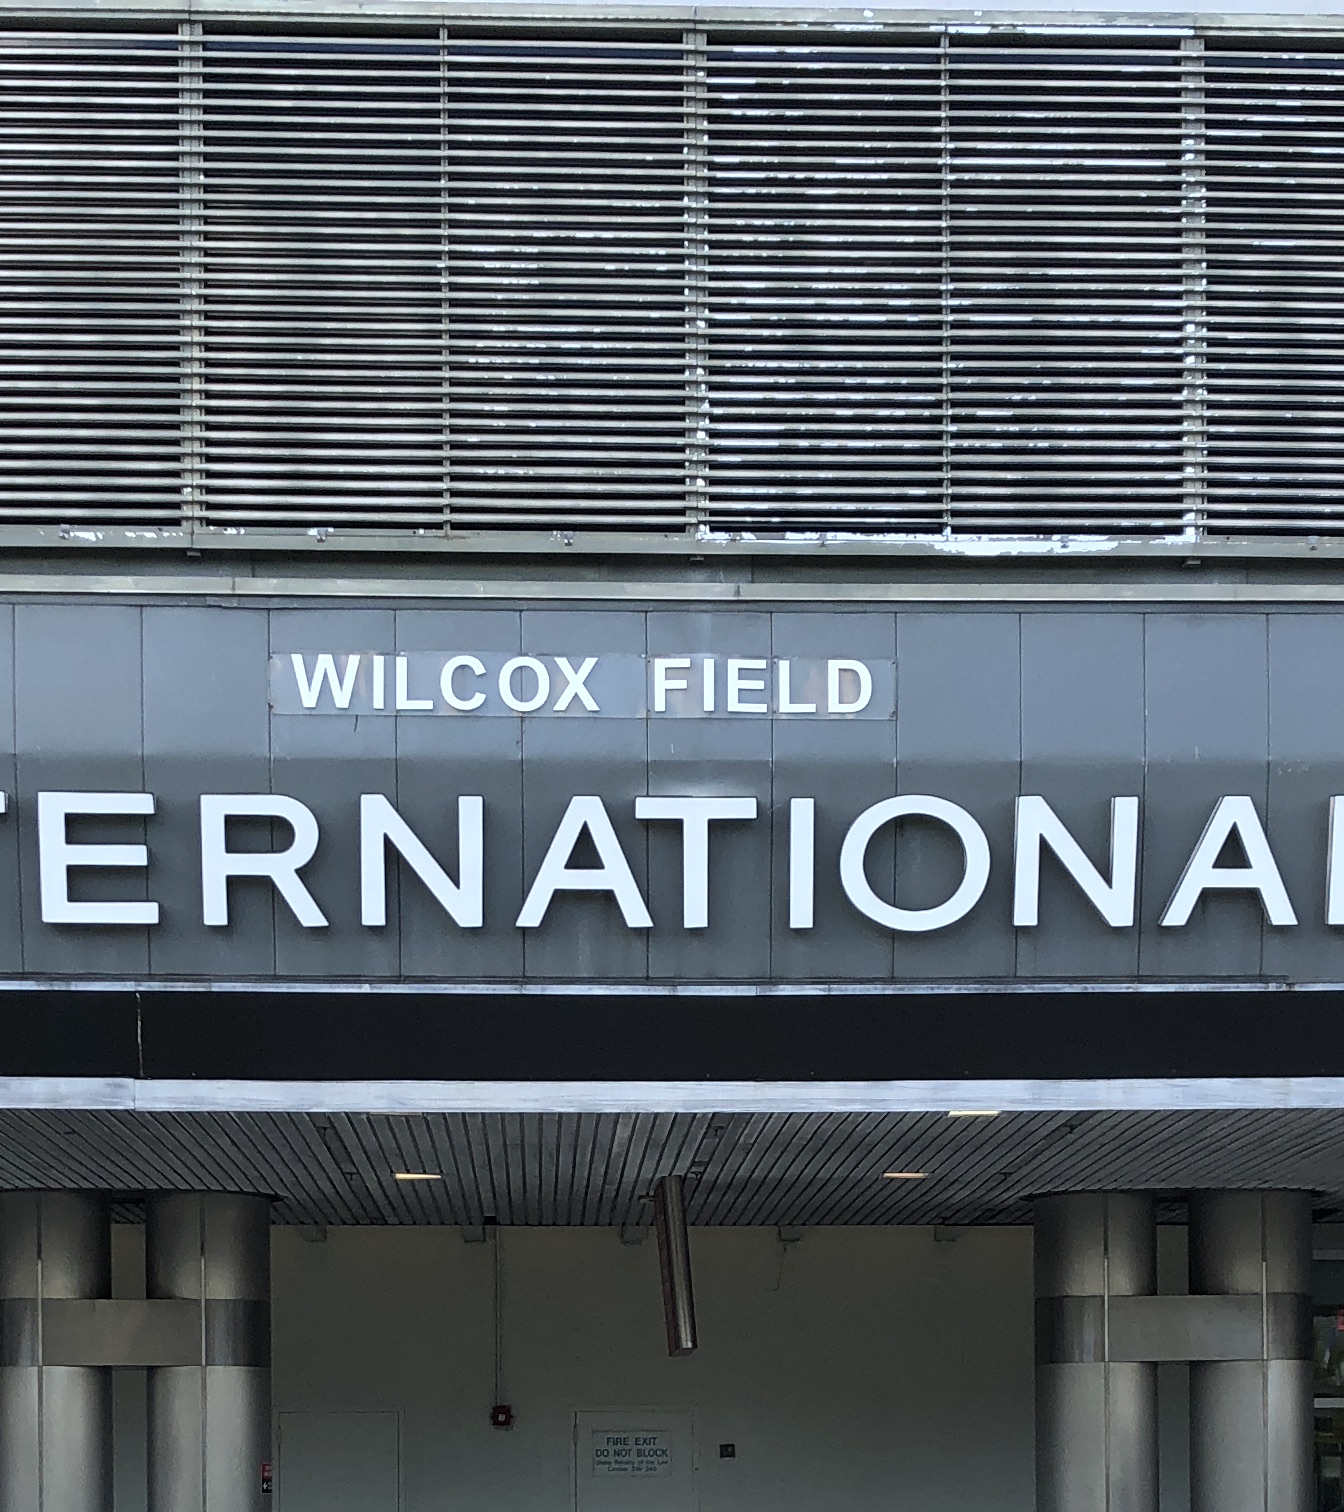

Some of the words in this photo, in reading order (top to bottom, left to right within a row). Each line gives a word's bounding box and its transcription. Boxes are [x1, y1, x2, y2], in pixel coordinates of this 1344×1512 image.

[289, 653, 601, 712] WILCOX
[653, 656, 873, 714] FIELD
[606, 1437, 629, 1446] FIRE
[634, 1437, 657, 1446] EXIT
[595, 1449, 610, 1458] DO
[613, 1449, 632, 1458] NOT
[636, 1449, 668, 1458] BLOCK
